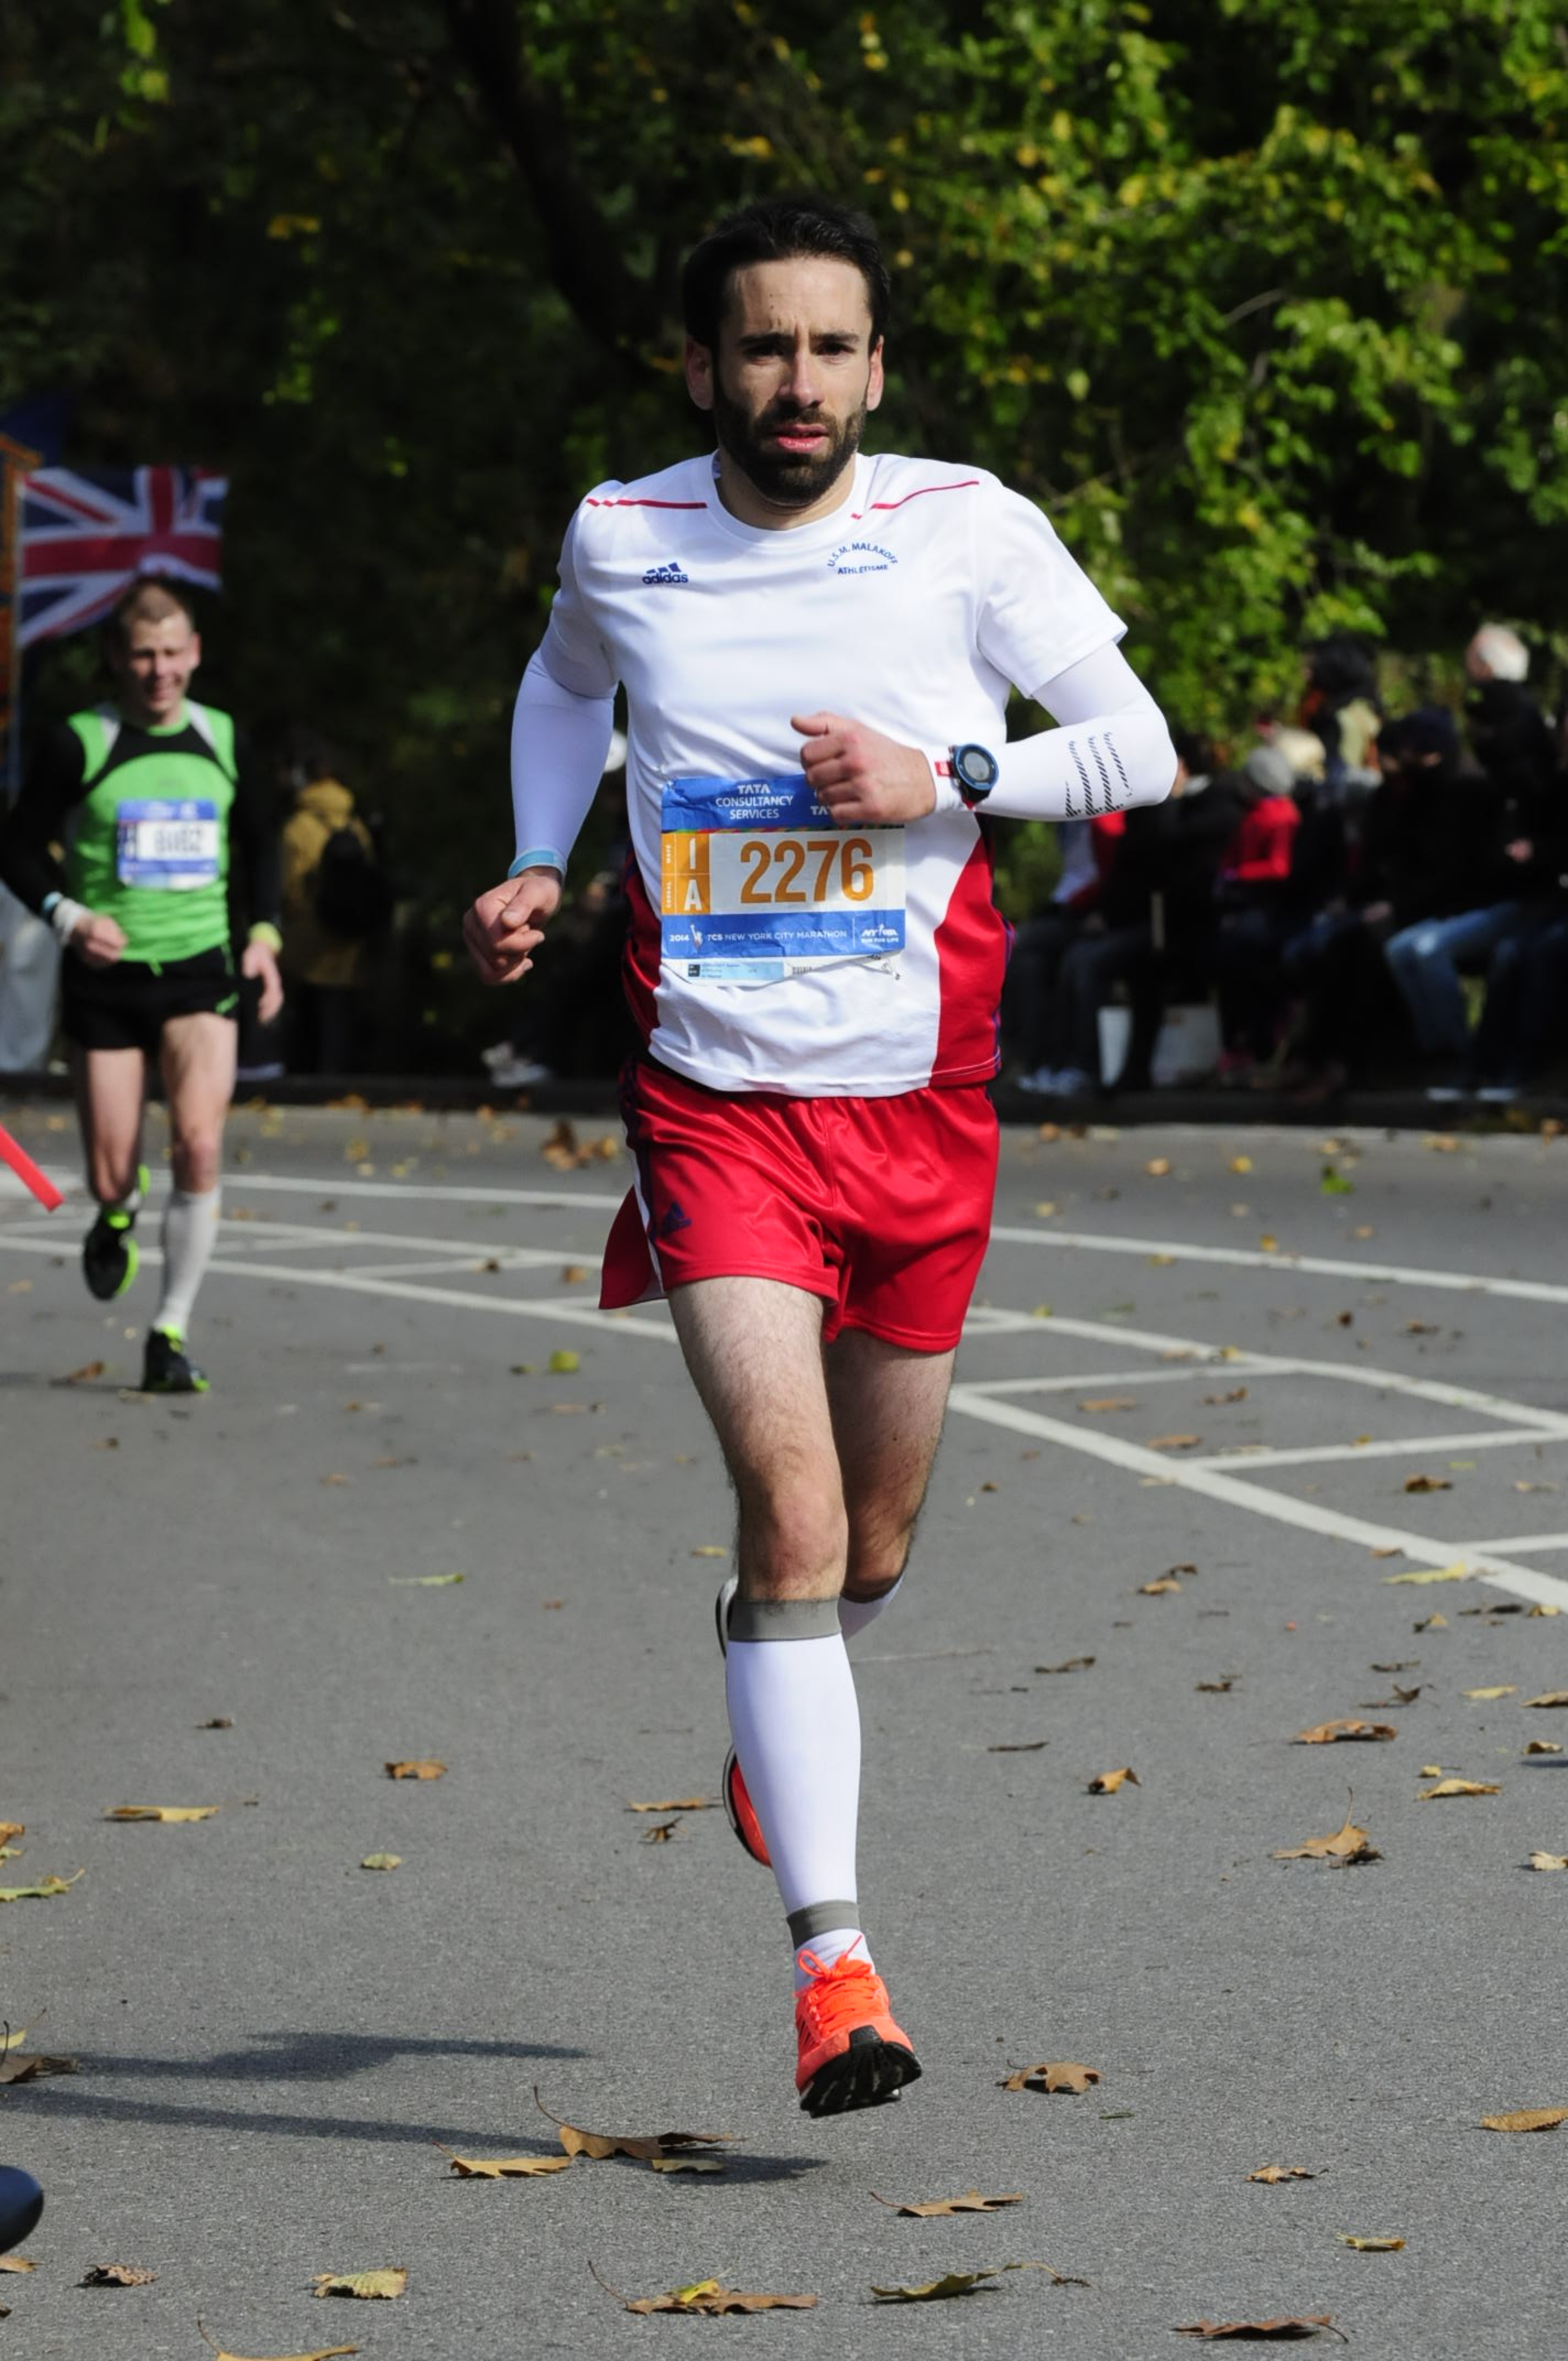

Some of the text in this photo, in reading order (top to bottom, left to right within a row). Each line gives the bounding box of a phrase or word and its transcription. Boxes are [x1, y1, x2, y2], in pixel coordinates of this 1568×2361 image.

[852, 542, 898, 564] MALAKOFF
[642, 572, 689, 585] adidas
[737, 784, 771, 794] TATA
[715, 796, 794, 807] CONSULTANCY
[729, 809, 780, 819] SERVICES
[740, 837, 874, 904] 2276
[683, 879, 702, 911] A
[669, 934, 690, 942] 2014
[774, 931, 794, 940] CITY
[797, 930, 847, 939] MARATHON
